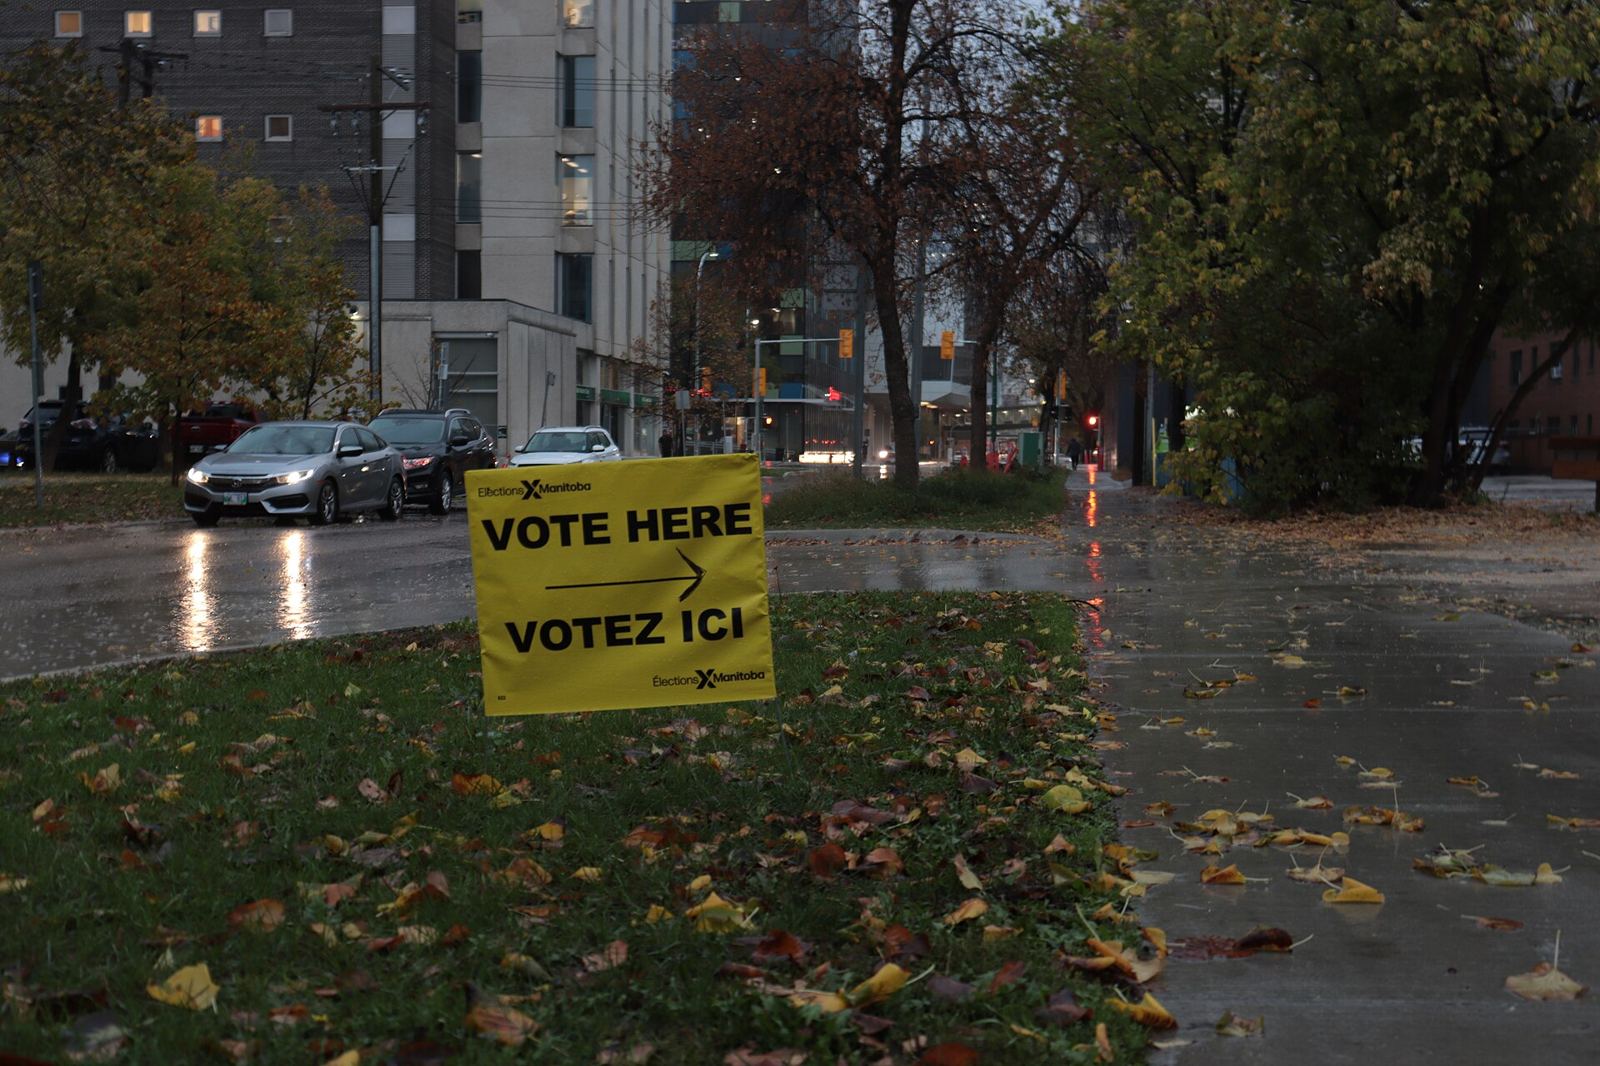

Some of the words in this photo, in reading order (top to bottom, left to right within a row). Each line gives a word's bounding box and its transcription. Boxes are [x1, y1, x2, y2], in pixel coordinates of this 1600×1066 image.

[539, 482, 591, 494] Manitoba
[481, 512, 611, 551] VOTE
[626, 503, 752, 542] HERE
[504, 612, 665, 653] VOTEZ
[681, 607, 744, 642] ICI
[652, 675, 699, 687] Élections
[713, 671, 765, 682] Manitoba
